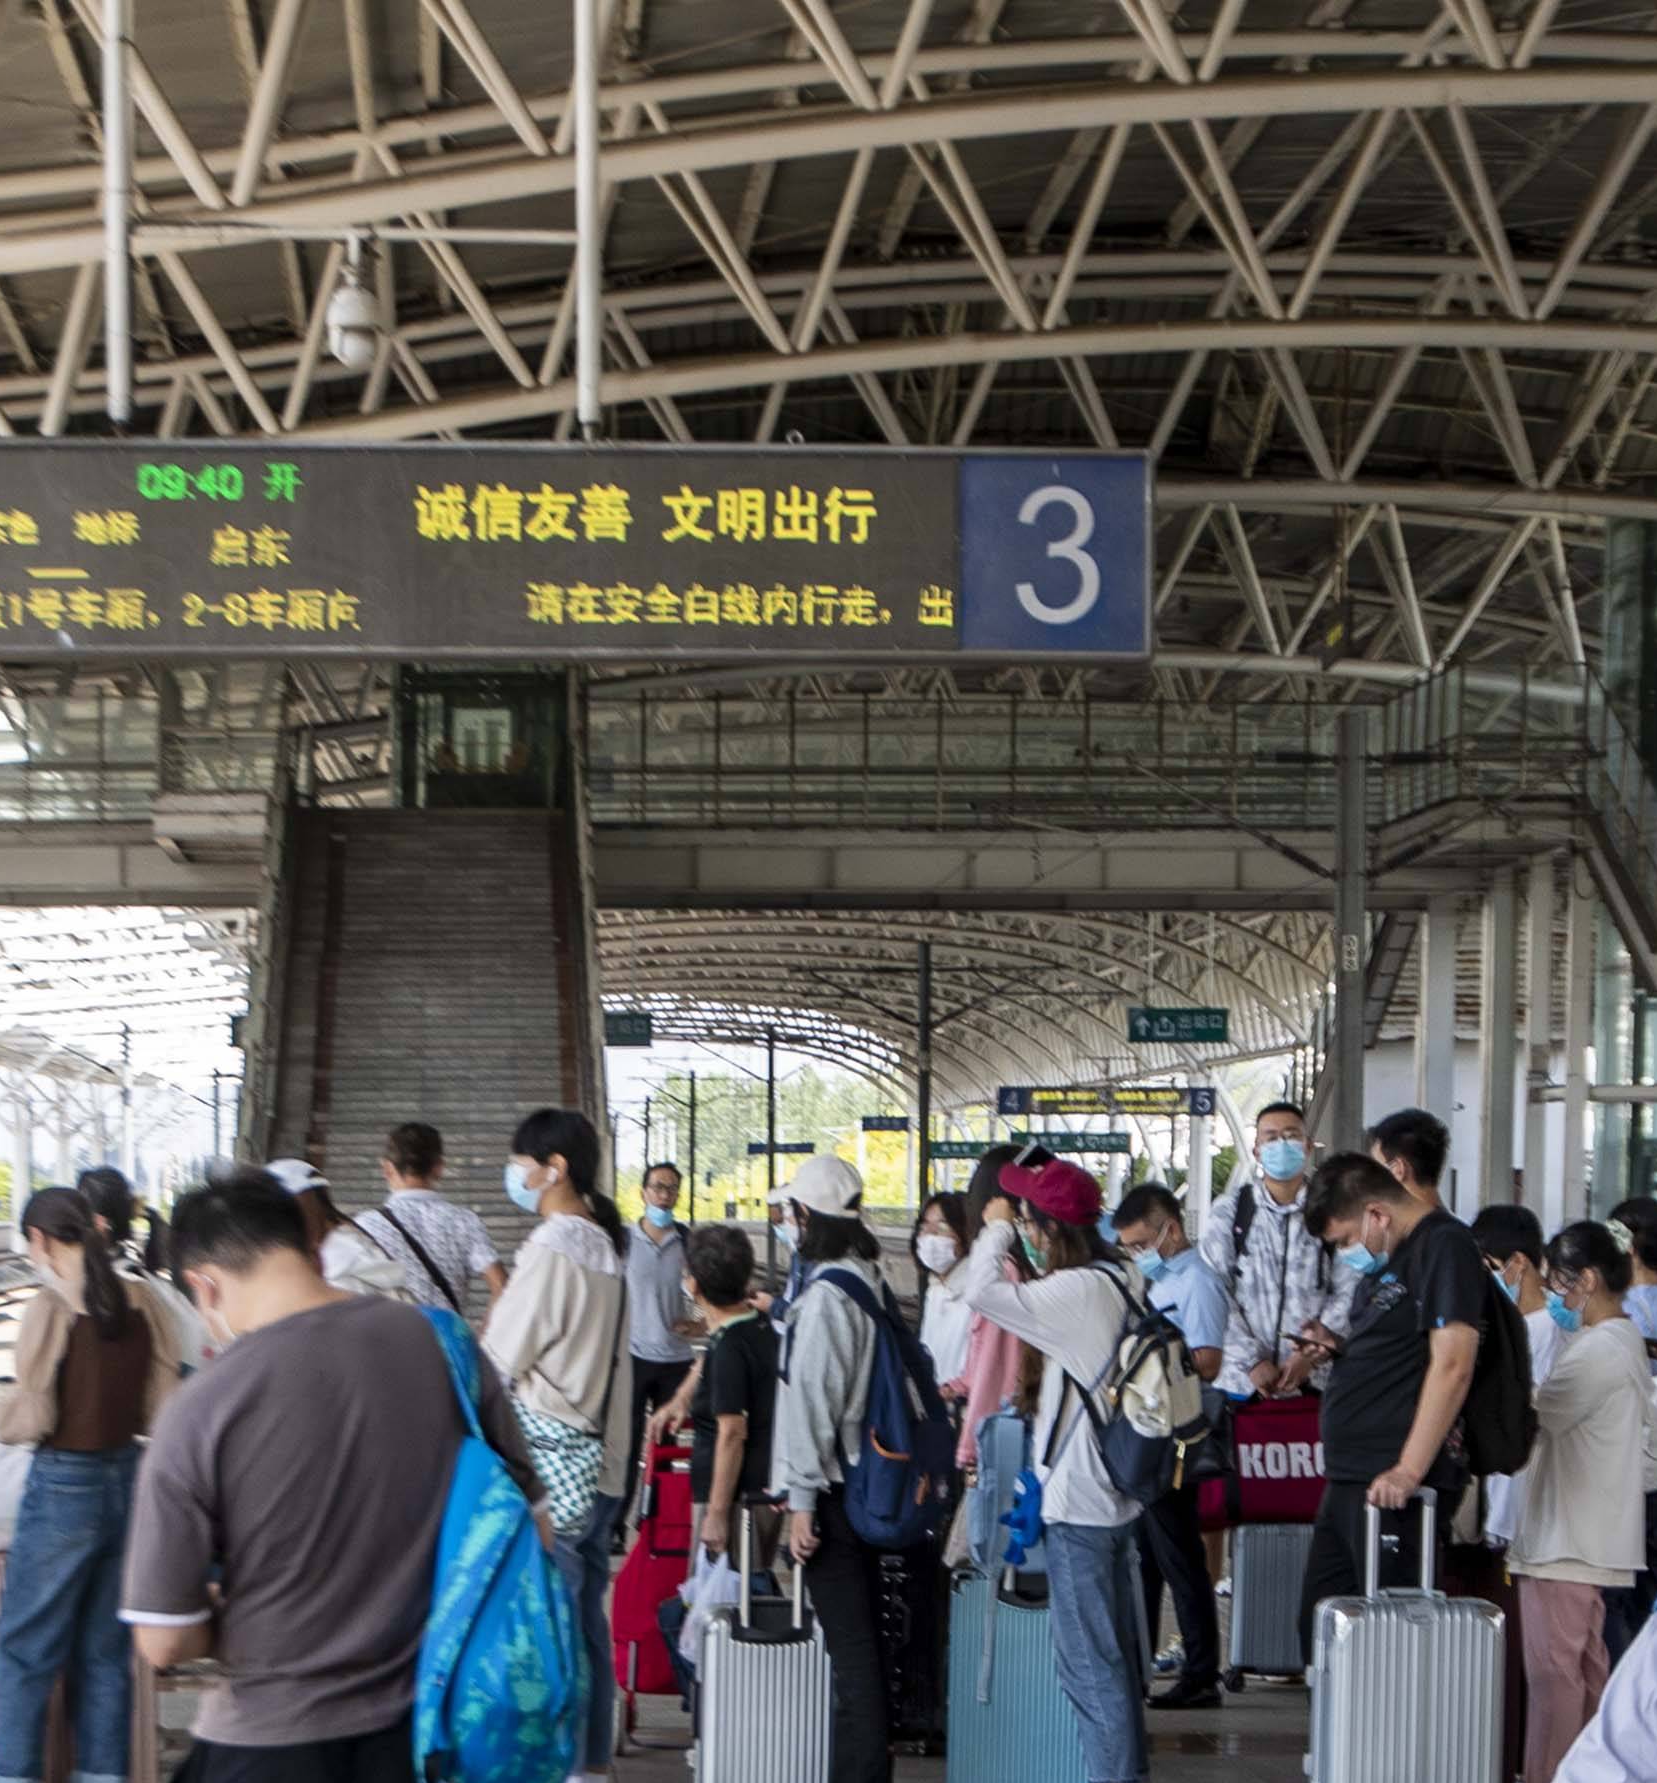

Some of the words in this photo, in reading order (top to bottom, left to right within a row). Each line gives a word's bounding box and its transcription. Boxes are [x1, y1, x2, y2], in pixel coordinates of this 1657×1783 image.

[262, 462, 303, 502] 开
[414, 483, 633, 542] 诚信友善
[662, 484, 878, 544] 文明出行
[209, 523, 291, 568] 启东
[1016, 484, 1101, 625] 3
[1196, 1091, 1211, 1112] 5
